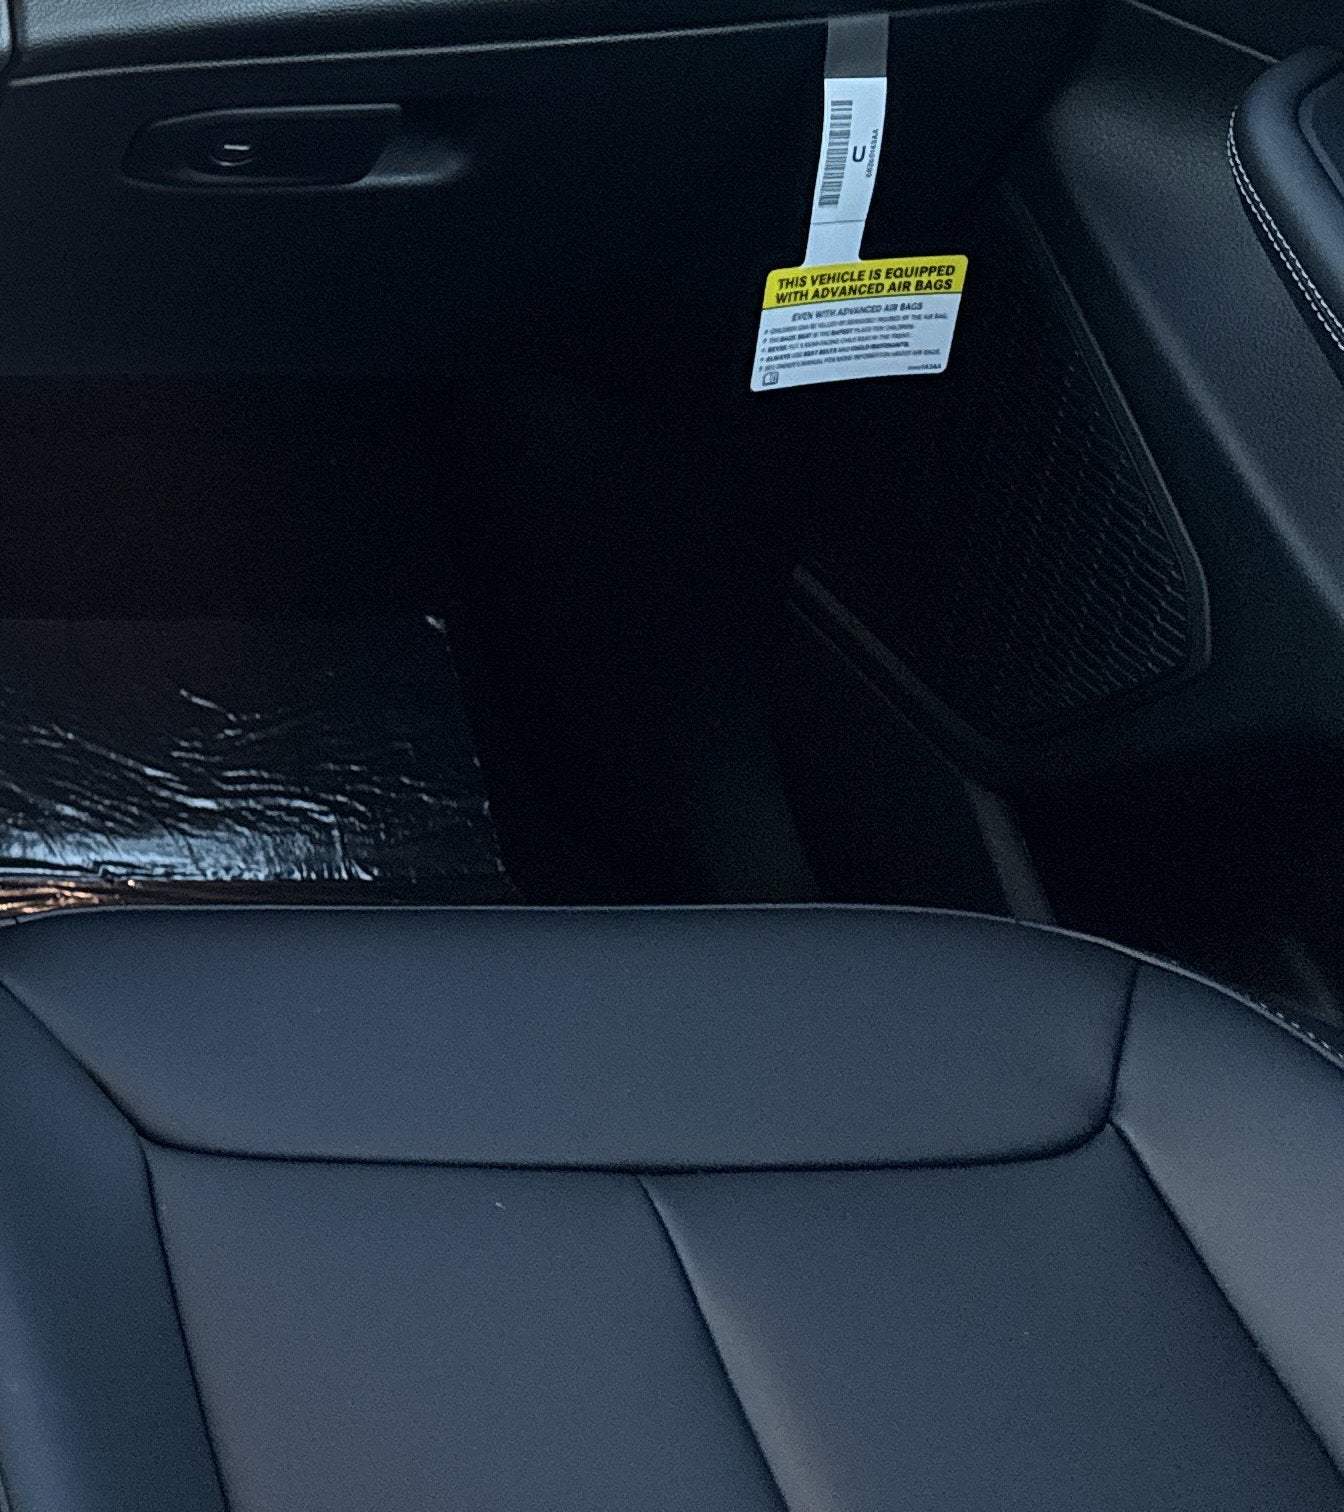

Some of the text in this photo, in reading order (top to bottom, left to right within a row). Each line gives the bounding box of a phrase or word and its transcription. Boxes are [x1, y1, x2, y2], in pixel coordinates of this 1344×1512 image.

[852, 145, 866, 162] U
[778, 265, 955, 290] THIS VEHICLE IS EQUIPPED
[776, 279, 953, 304] WITH ADVANCED AIR BAGS
[837, 305, 882, 316] ADVANCED
[900, 302, 923, 311] BAGS
